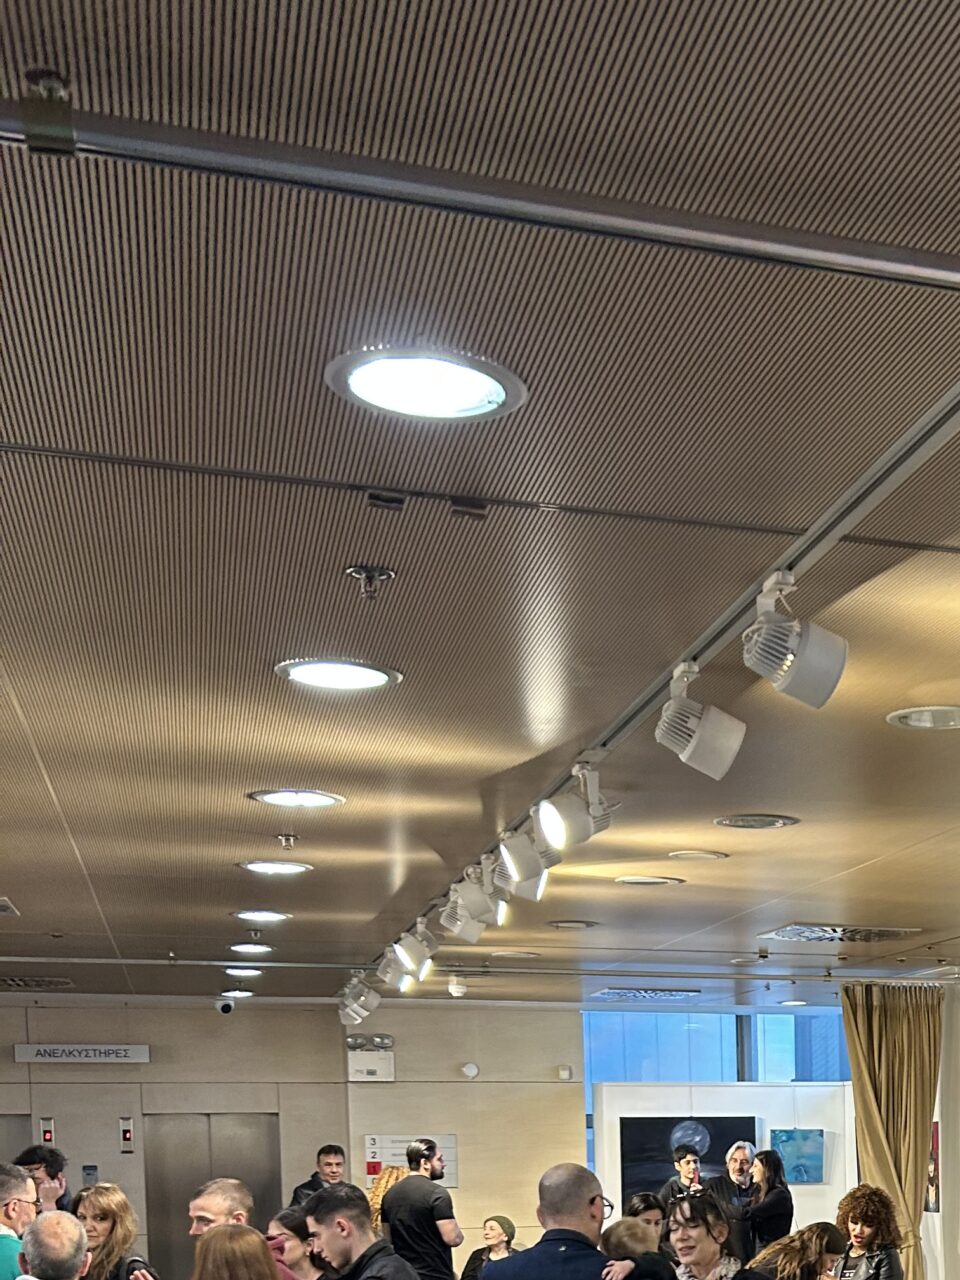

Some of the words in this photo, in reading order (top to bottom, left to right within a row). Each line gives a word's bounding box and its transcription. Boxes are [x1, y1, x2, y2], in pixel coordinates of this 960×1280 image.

[35, 1048, 130, 1058] ΑΝΕΛΚΥΣΤΗΡΕΣ
[370, 1138, 376, 1146] 3
[371, 1151, 377, 1159] 2
